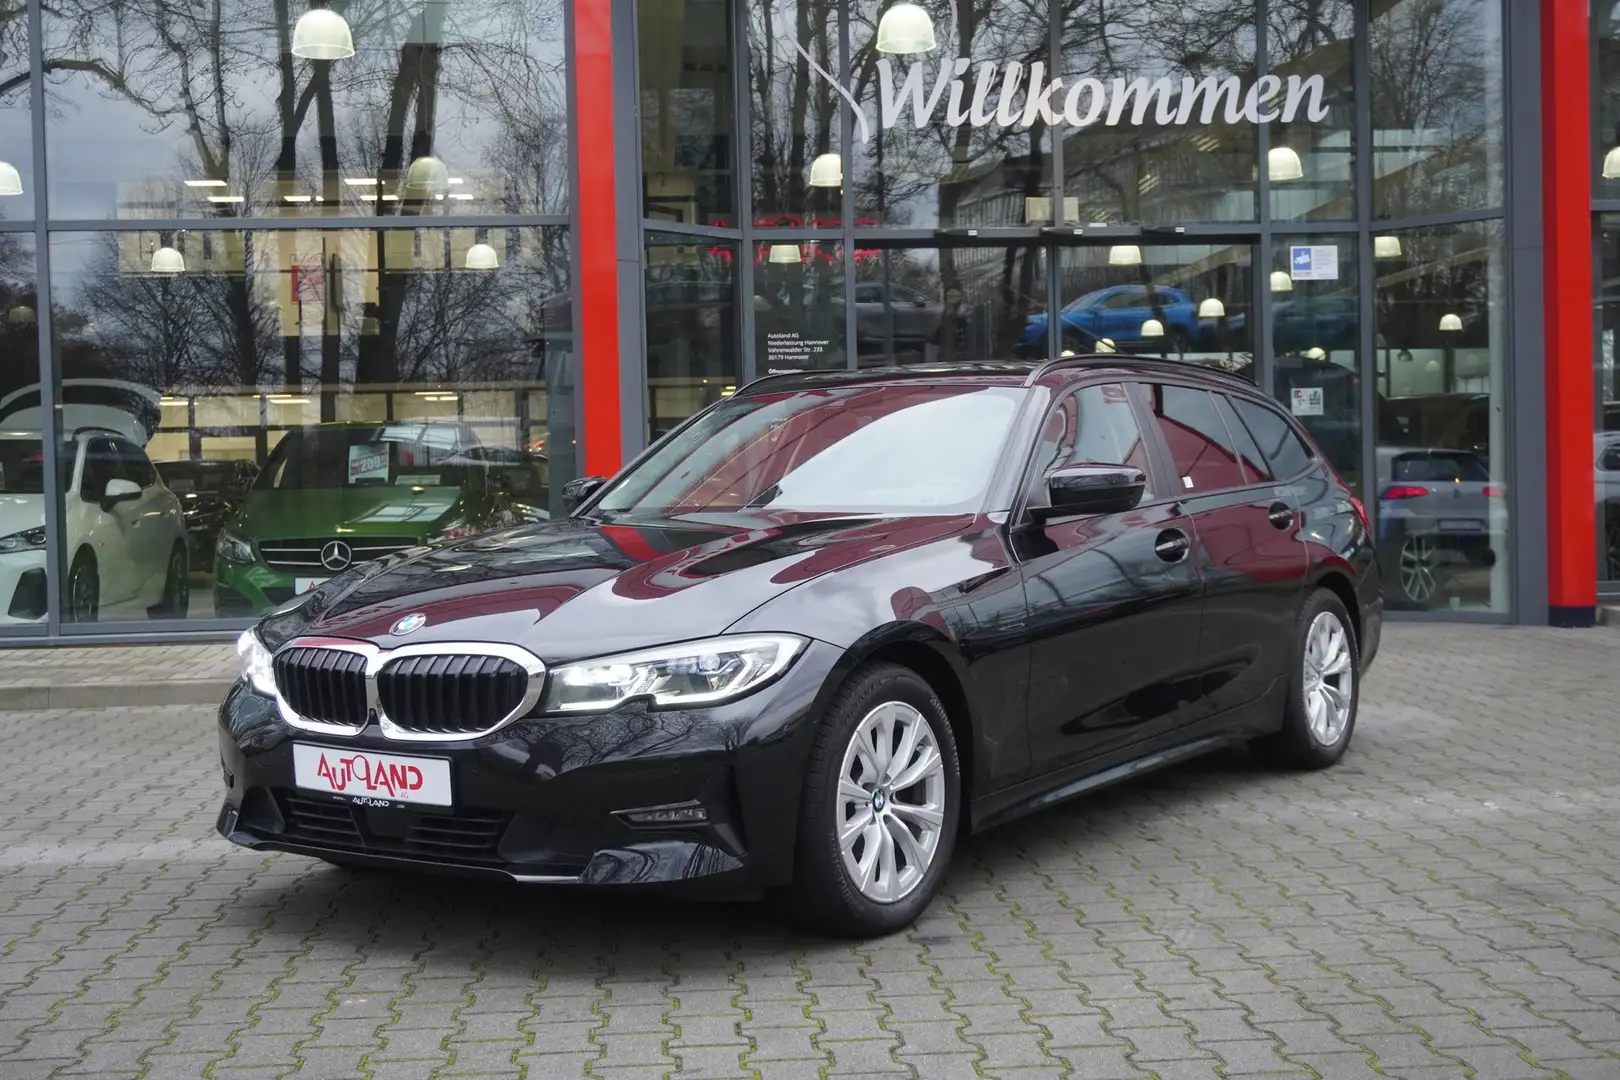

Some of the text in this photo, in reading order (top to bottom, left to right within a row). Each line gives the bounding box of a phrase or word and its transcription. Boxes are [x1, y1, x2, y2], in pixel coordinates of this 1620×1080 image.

[877, 57, 1329, 128] Willkommen
[317, 752, 423, 797] AUTOLAND
[352, 796, 390, 808] AUTOLAND
